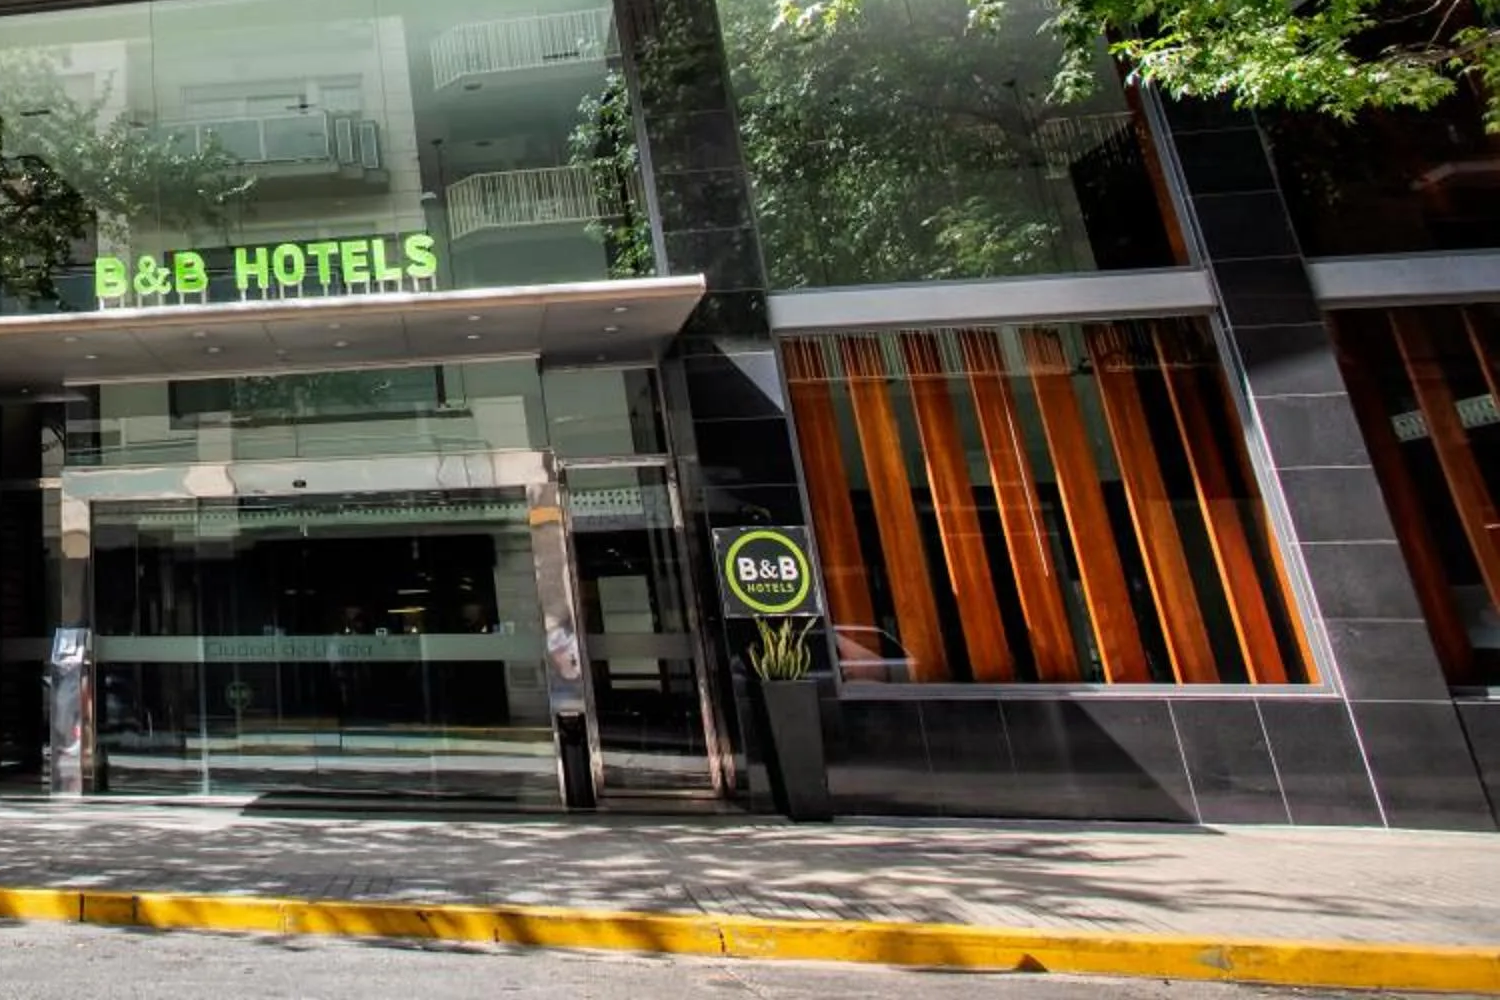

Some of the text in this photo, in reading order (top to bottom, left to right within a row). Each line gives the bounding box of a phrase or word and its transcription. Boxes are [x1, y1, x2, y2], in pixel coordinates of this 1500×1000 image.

[95, 234, 437, 297] B&B HOTELS
[737, 555, 798, 581] B&B
[746, 583, 795, 593] HOTELS
